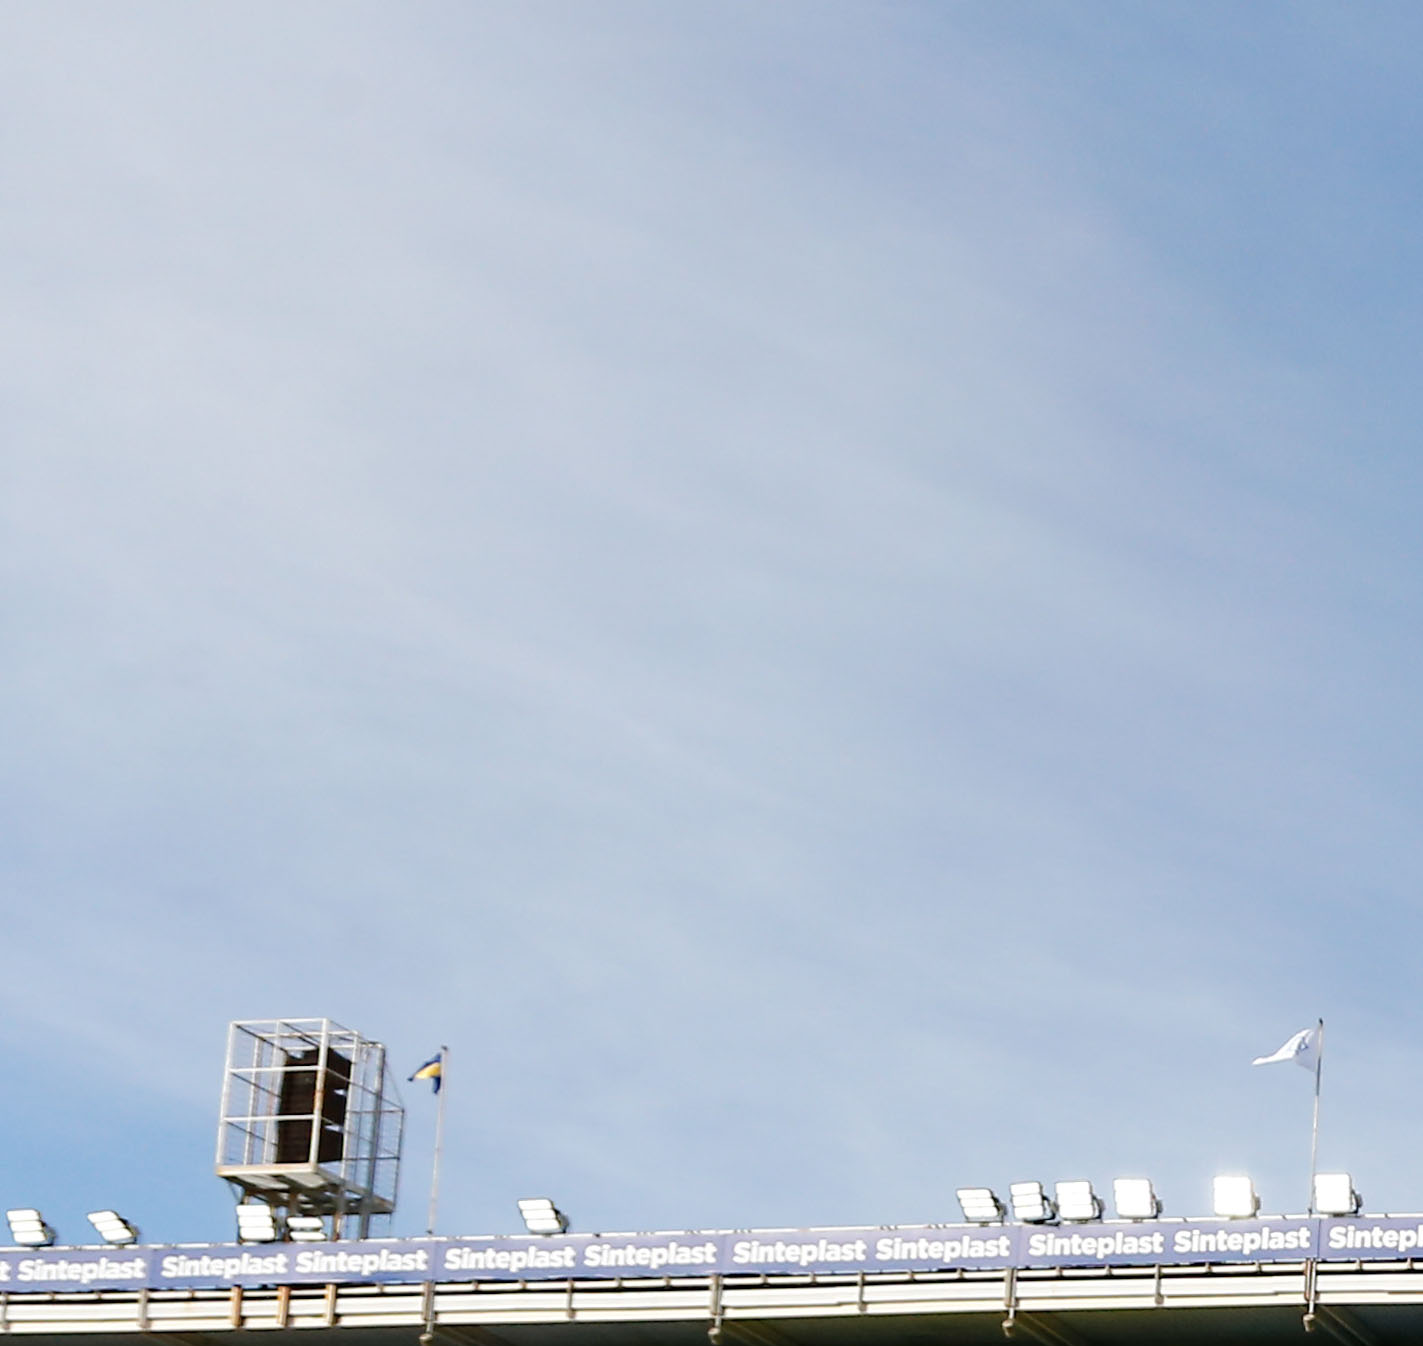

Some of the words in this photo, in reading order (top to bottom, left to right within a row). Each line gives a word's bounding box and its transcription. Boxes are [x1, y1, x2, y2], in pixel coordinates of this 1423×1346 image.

[17, 1257, 146, 1284] Sinteplast
[161, 1251, 287, 1279] Sinteplast
[295, 1248, 428, 1277] Sinteplast
[445, 1245, 575, 1274] Sinteplast
[584, 1242, 716, 1272] Sinteplast
[733, 1239, 866, 1269] Sinteplast
[876, 1236, 1010, 1266] Sinteplast
[1029, 1232, 1163, 1261] Sinteplast
[1174, 1228, 1310, 1259] Sinteplast
